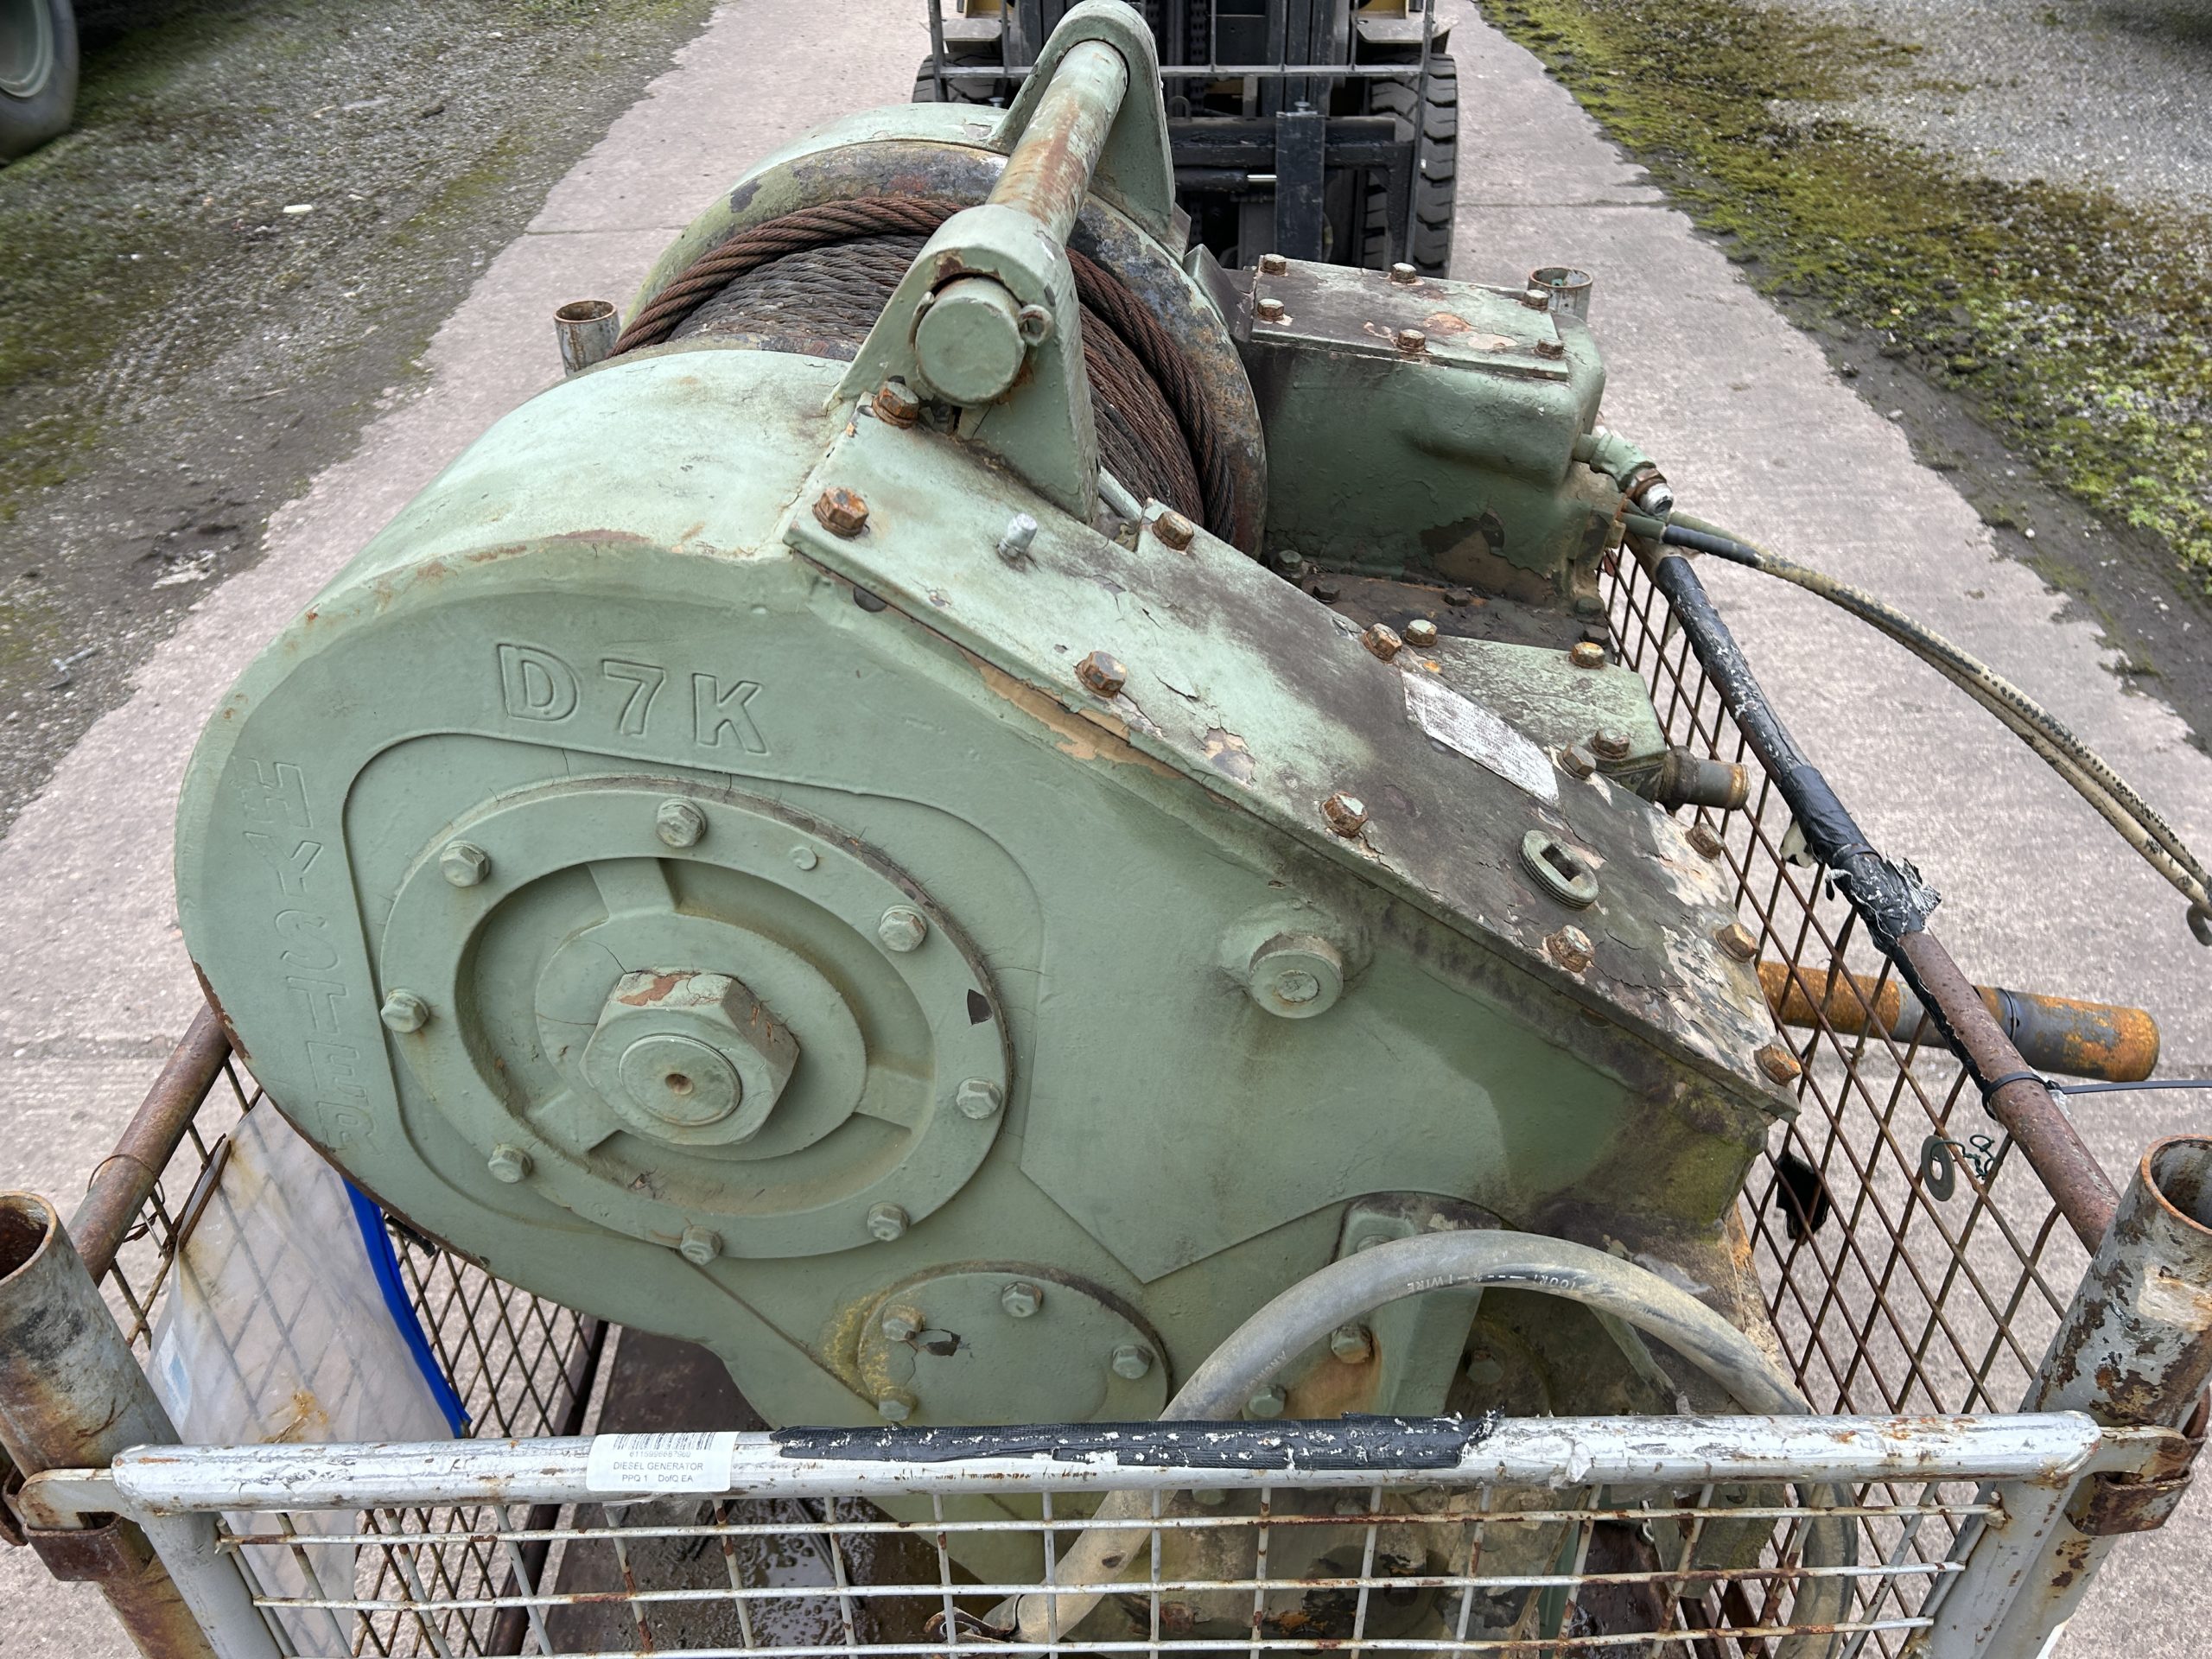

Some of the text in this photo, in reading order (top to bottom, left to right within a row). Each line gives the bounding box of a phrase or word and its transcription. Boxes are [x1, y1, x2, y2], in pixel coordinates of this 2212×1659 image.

[231, 754, 382, 1156] HYSTER
[1407, 1276, 1444, 1293] WIRE
[613, 1461, 703, 1471] DIESEL GENERATOR
[622, 1474, 641, 1483] PPQ
[658, 1474, 679, 1483] DofQ
[681, 1474, 693, 1483] EA
